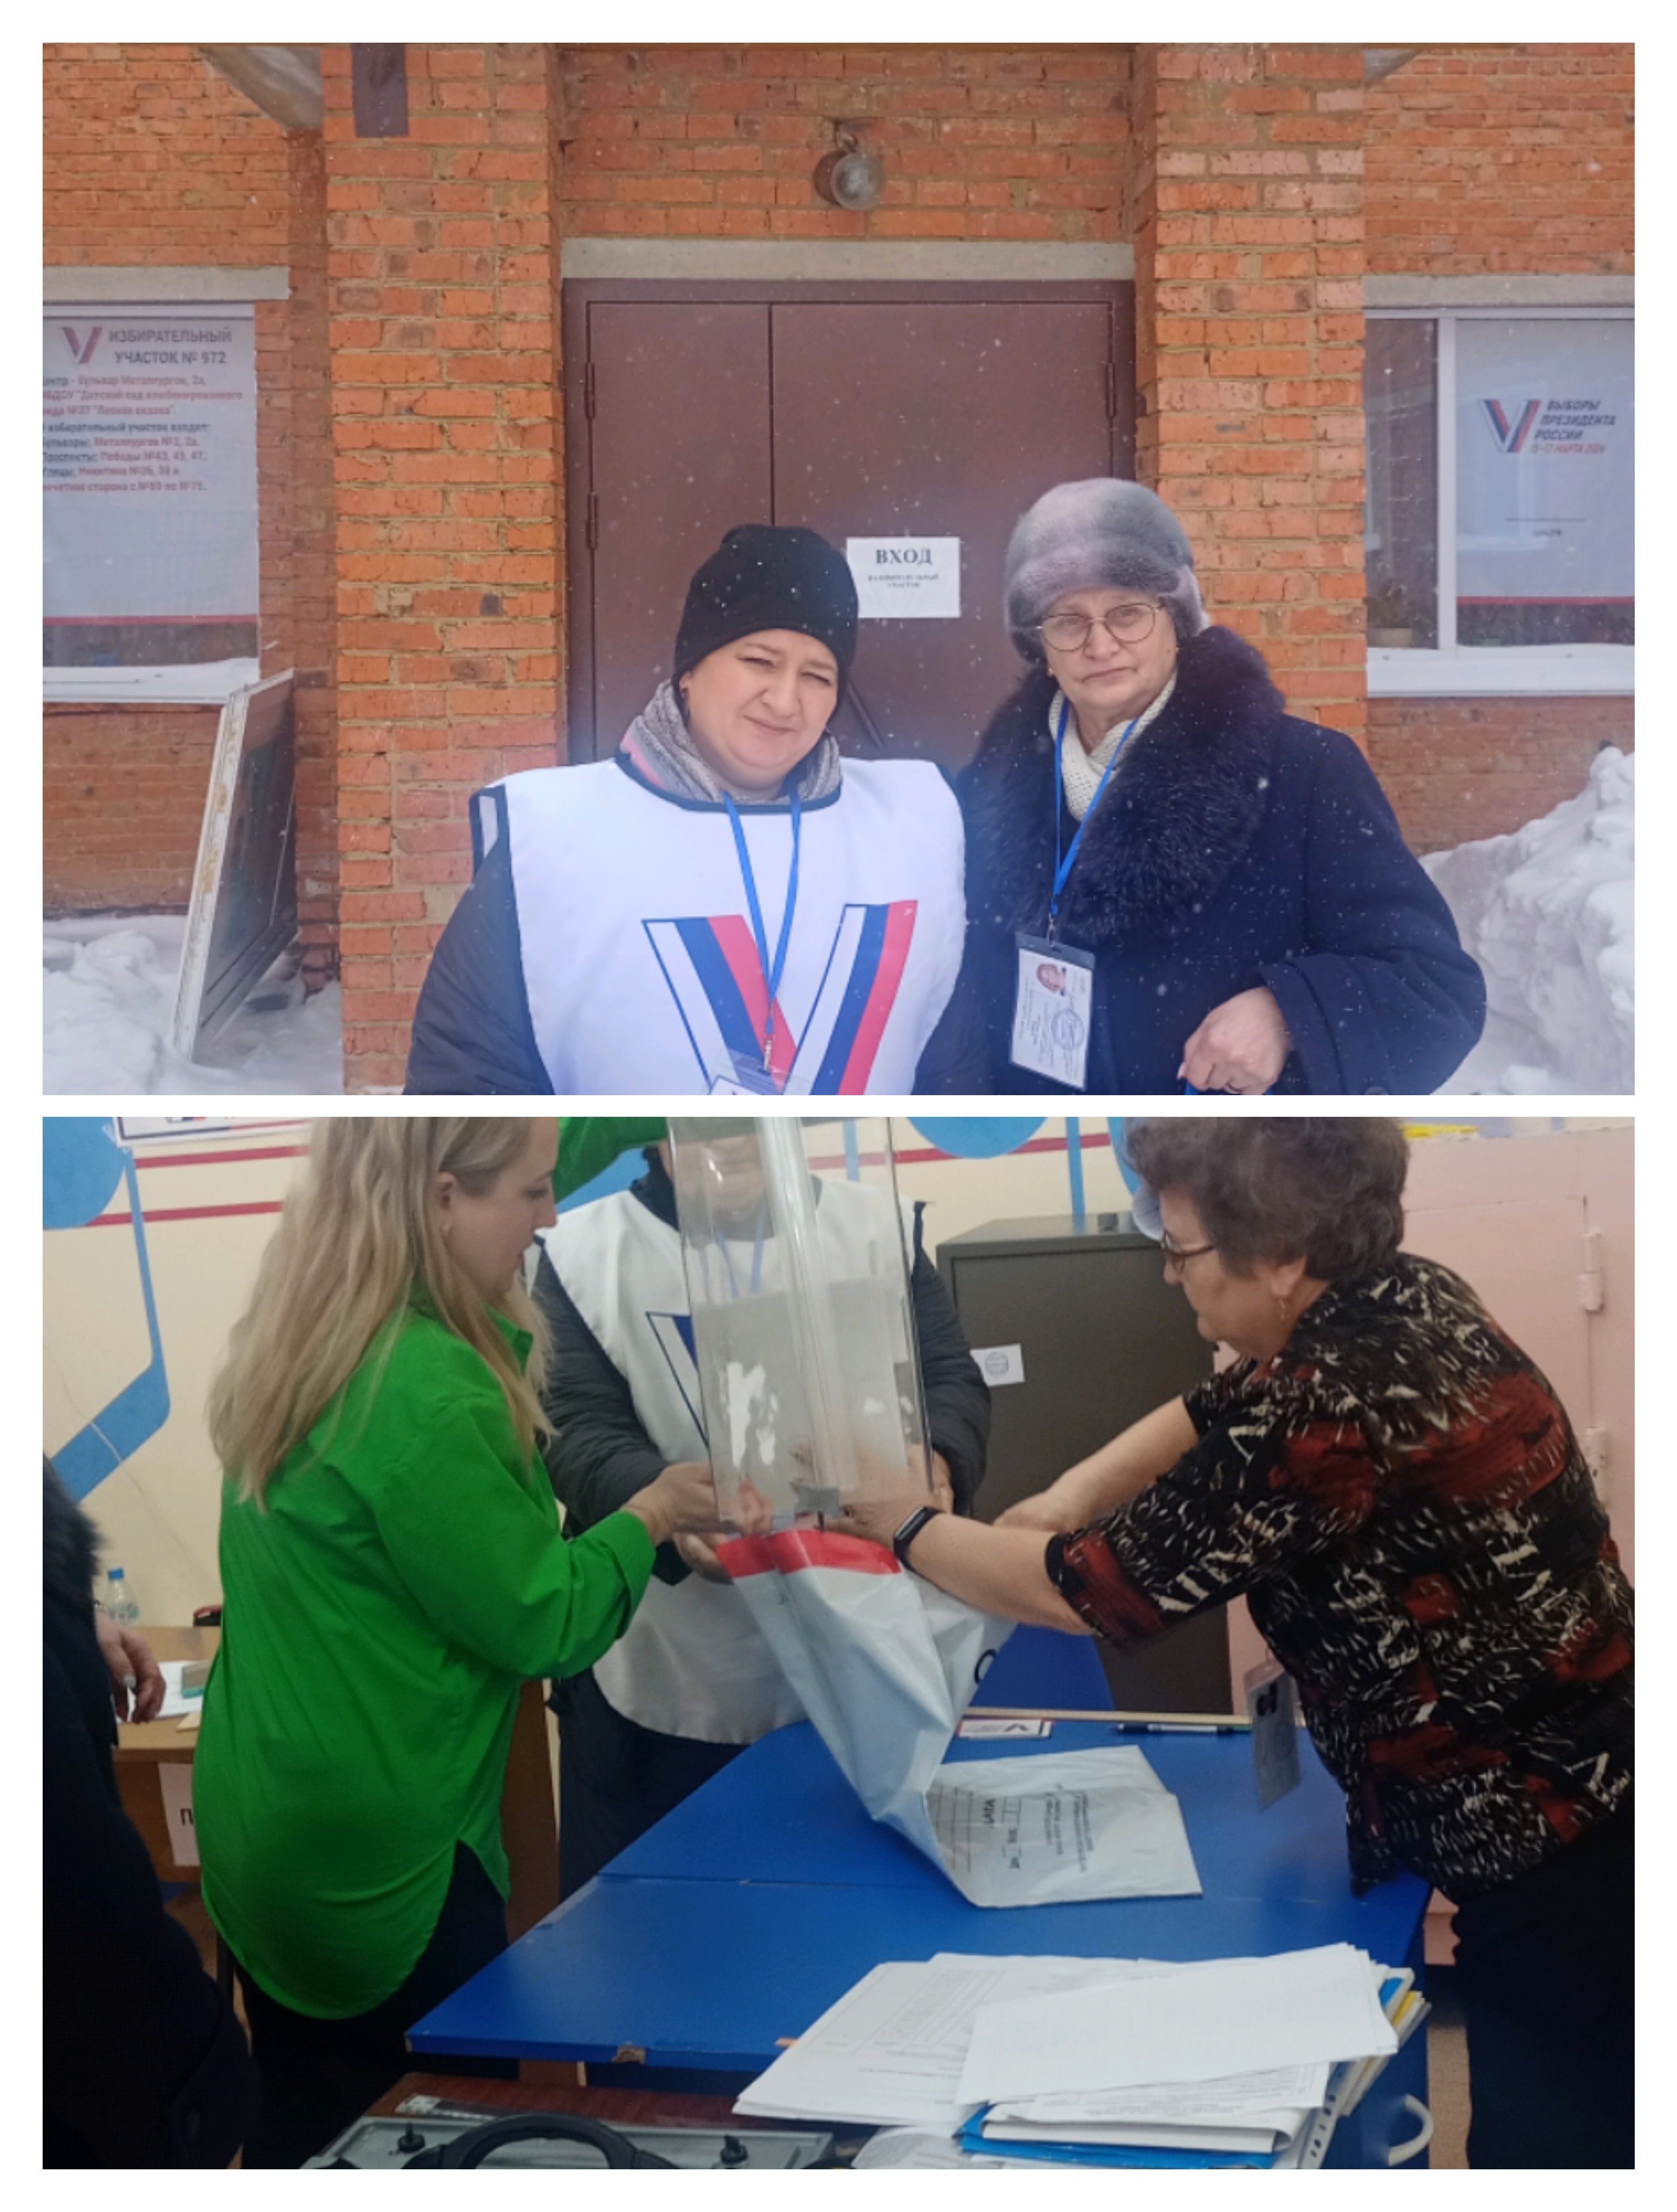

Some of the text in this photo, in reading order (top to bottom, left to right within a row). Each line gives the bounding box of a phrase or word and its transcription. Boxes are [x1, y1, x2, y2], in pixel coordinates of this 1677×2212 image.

[109, 327, 232, 342] ИЗБИРАТЕЛЬНЫЙ
[114, 351, 226, 364] УЧАСТОК № 972
[1546, 400, 1601, 412] ВЫБОРЫ
[1540, 414, 1615, 427] ПРЕЗИДЕНТА
[1534, 429, 1583, 440] РОССИИ
[875, 548, 932, 565] ВХОД
